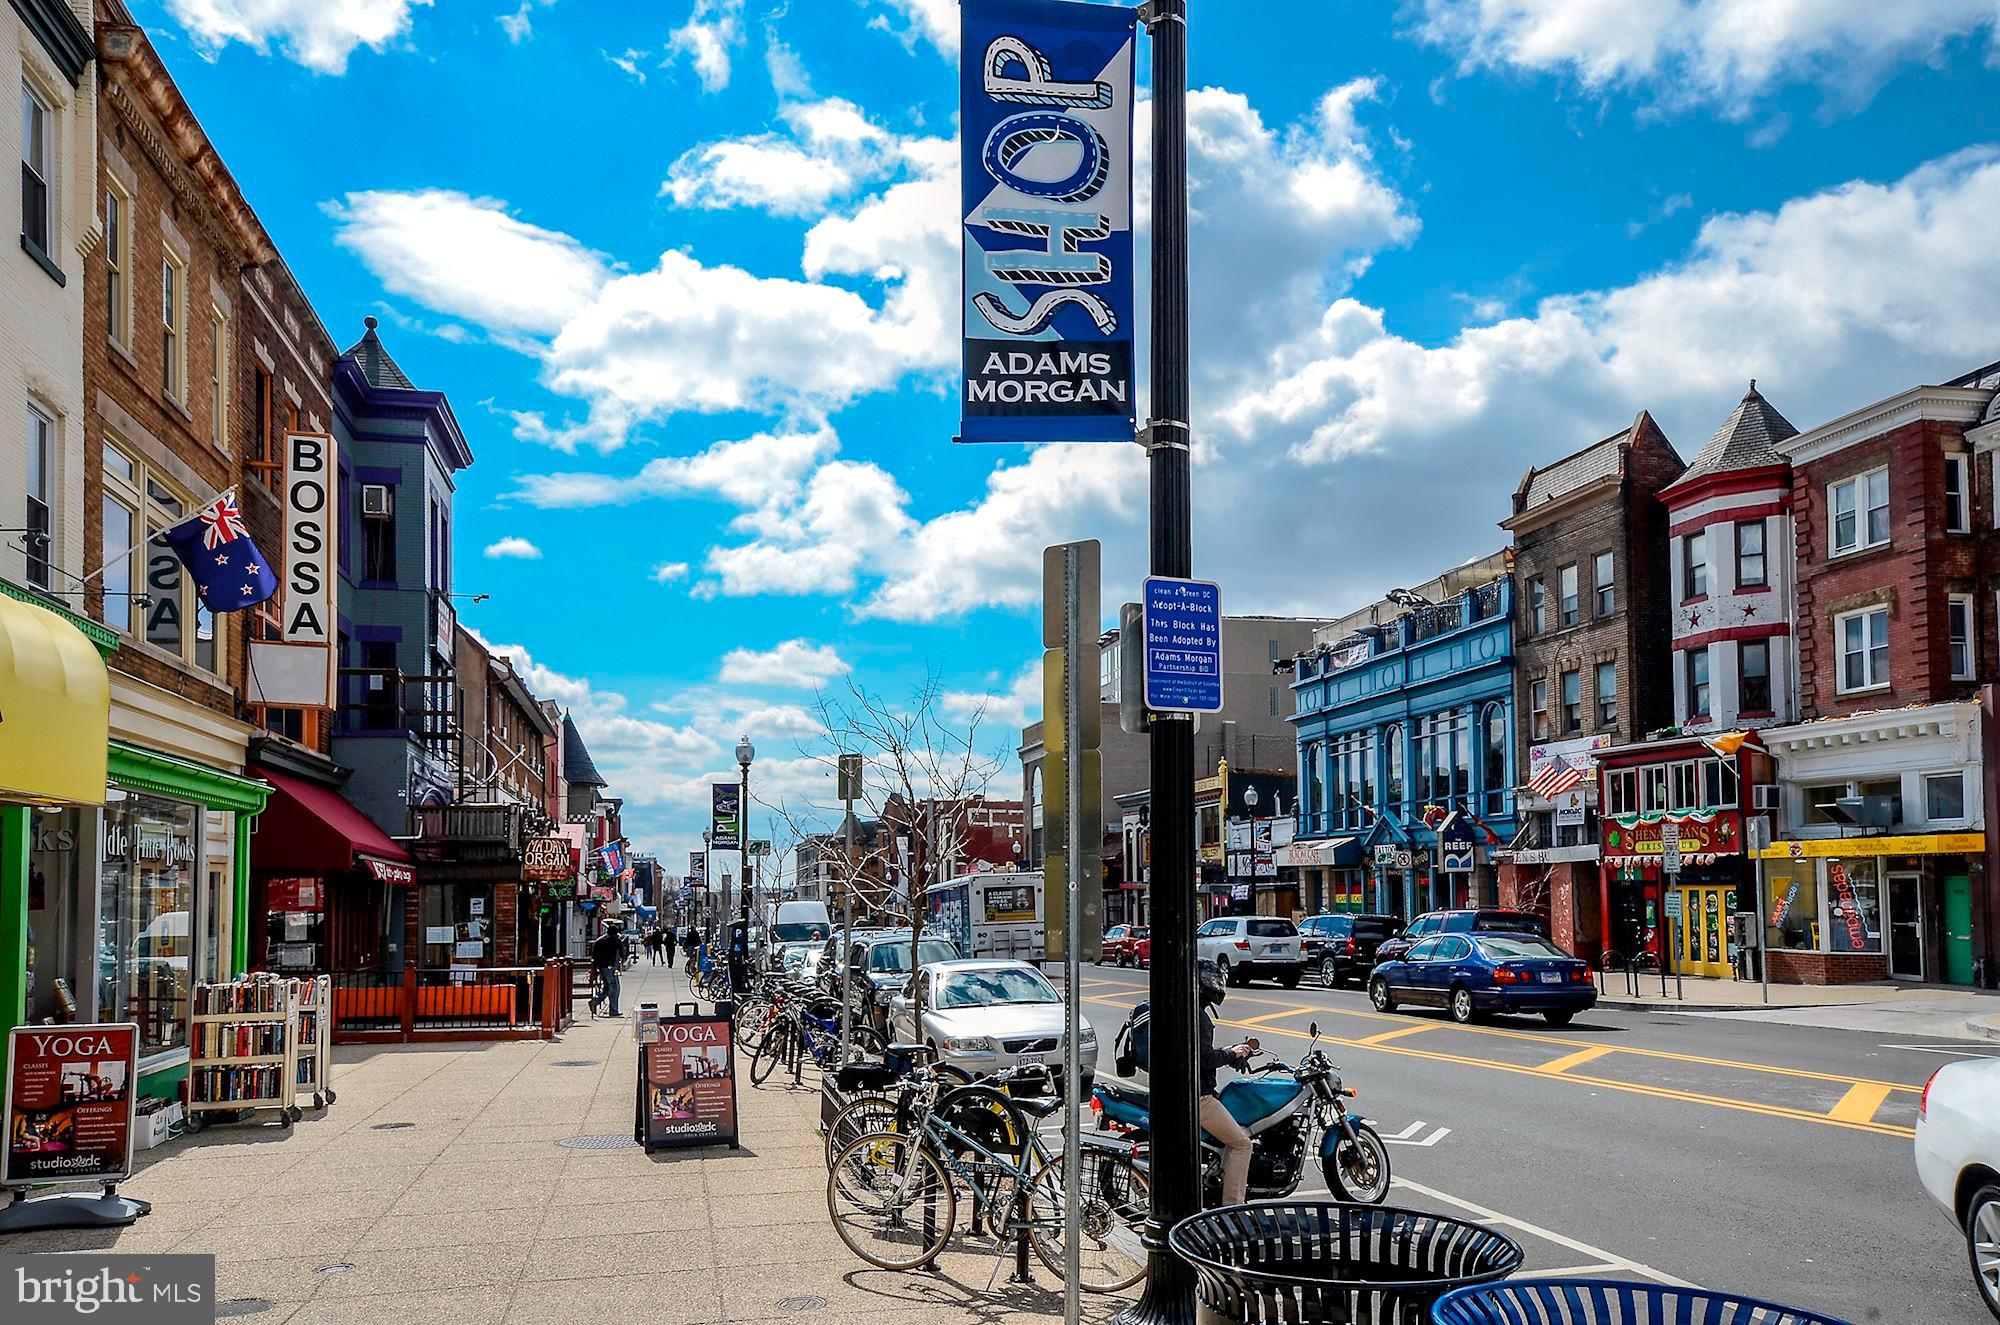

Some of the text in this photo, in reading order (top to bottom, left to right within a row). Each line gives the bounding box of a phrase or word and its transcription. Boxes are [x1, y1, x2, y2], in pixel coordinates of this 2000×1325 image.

[972, 36, 1118, 337] SHOP
[981, 352, 1111, 375] ADAMS
[967, 379, 1126, 403] MORGAN
[289, 439, 326, 635] BOSSA
[1202, 591, 1211, 599] DC
[1152, 600, 1213, 613] Adopt-A-Block
[1151, 618, 1216, 632] This Block Has
[1149, 633, 1217, 647] Been Adopted By
[1155, 651, 1213, 664] Adams Morgan
[1158, 662, 1196, 672] Partnership
[716, 787, 738, 833] PLAY
[103, 820, 128, 862] Idle
[166, 827, 195, 867] Books
[1624, 825, 1710, 851] SHENAGANS
[1444, 841, 1473, 851] REEF
[1641, 840, 1694, 851] IRIS UB
[525, 852, 570, 866] ORGAN
[735, 928, 742, 938] P
[660, 1025, 717, 1043] YOGA
[32, 1035, 114, 1057] YOGA
[77, 1106, 113, 1114] OFFERINGS
[665, 1121, 717, 1134] studio dc
[30, 1154, 101, 1170] studio dc
[944, 1161, 974, 1171] ADMS
